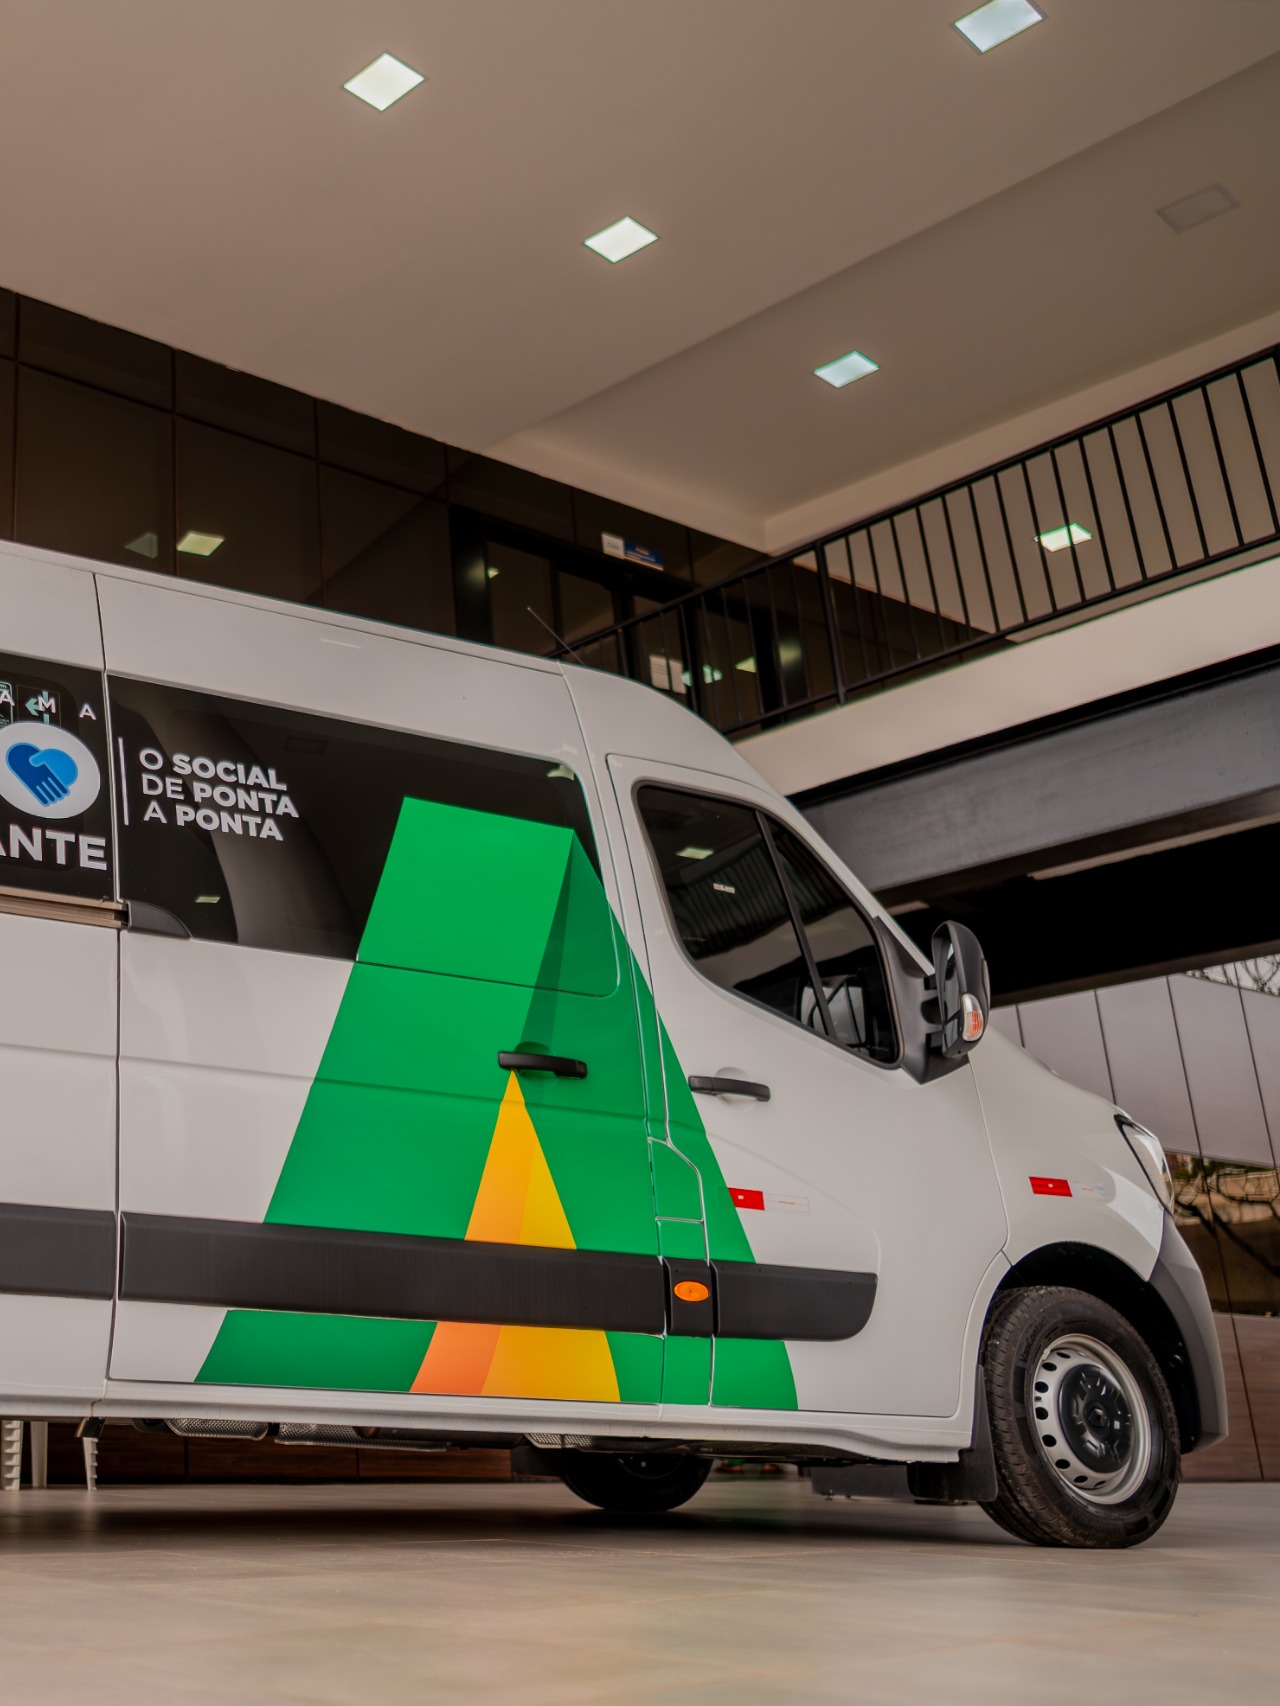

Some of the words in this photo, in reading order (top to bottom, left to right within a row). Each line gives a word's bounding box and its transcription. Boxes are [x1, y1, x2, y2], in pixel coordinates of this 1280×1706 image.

[139, 748, 163, 770] O
[172, 753, 287, 790] SOCIAL
[142, 773, 185, 800] DE
[193, 781, 299, 818] PONTA
[144, 801, 167, 824] A
[176, 805, 283, 841] PONTA
